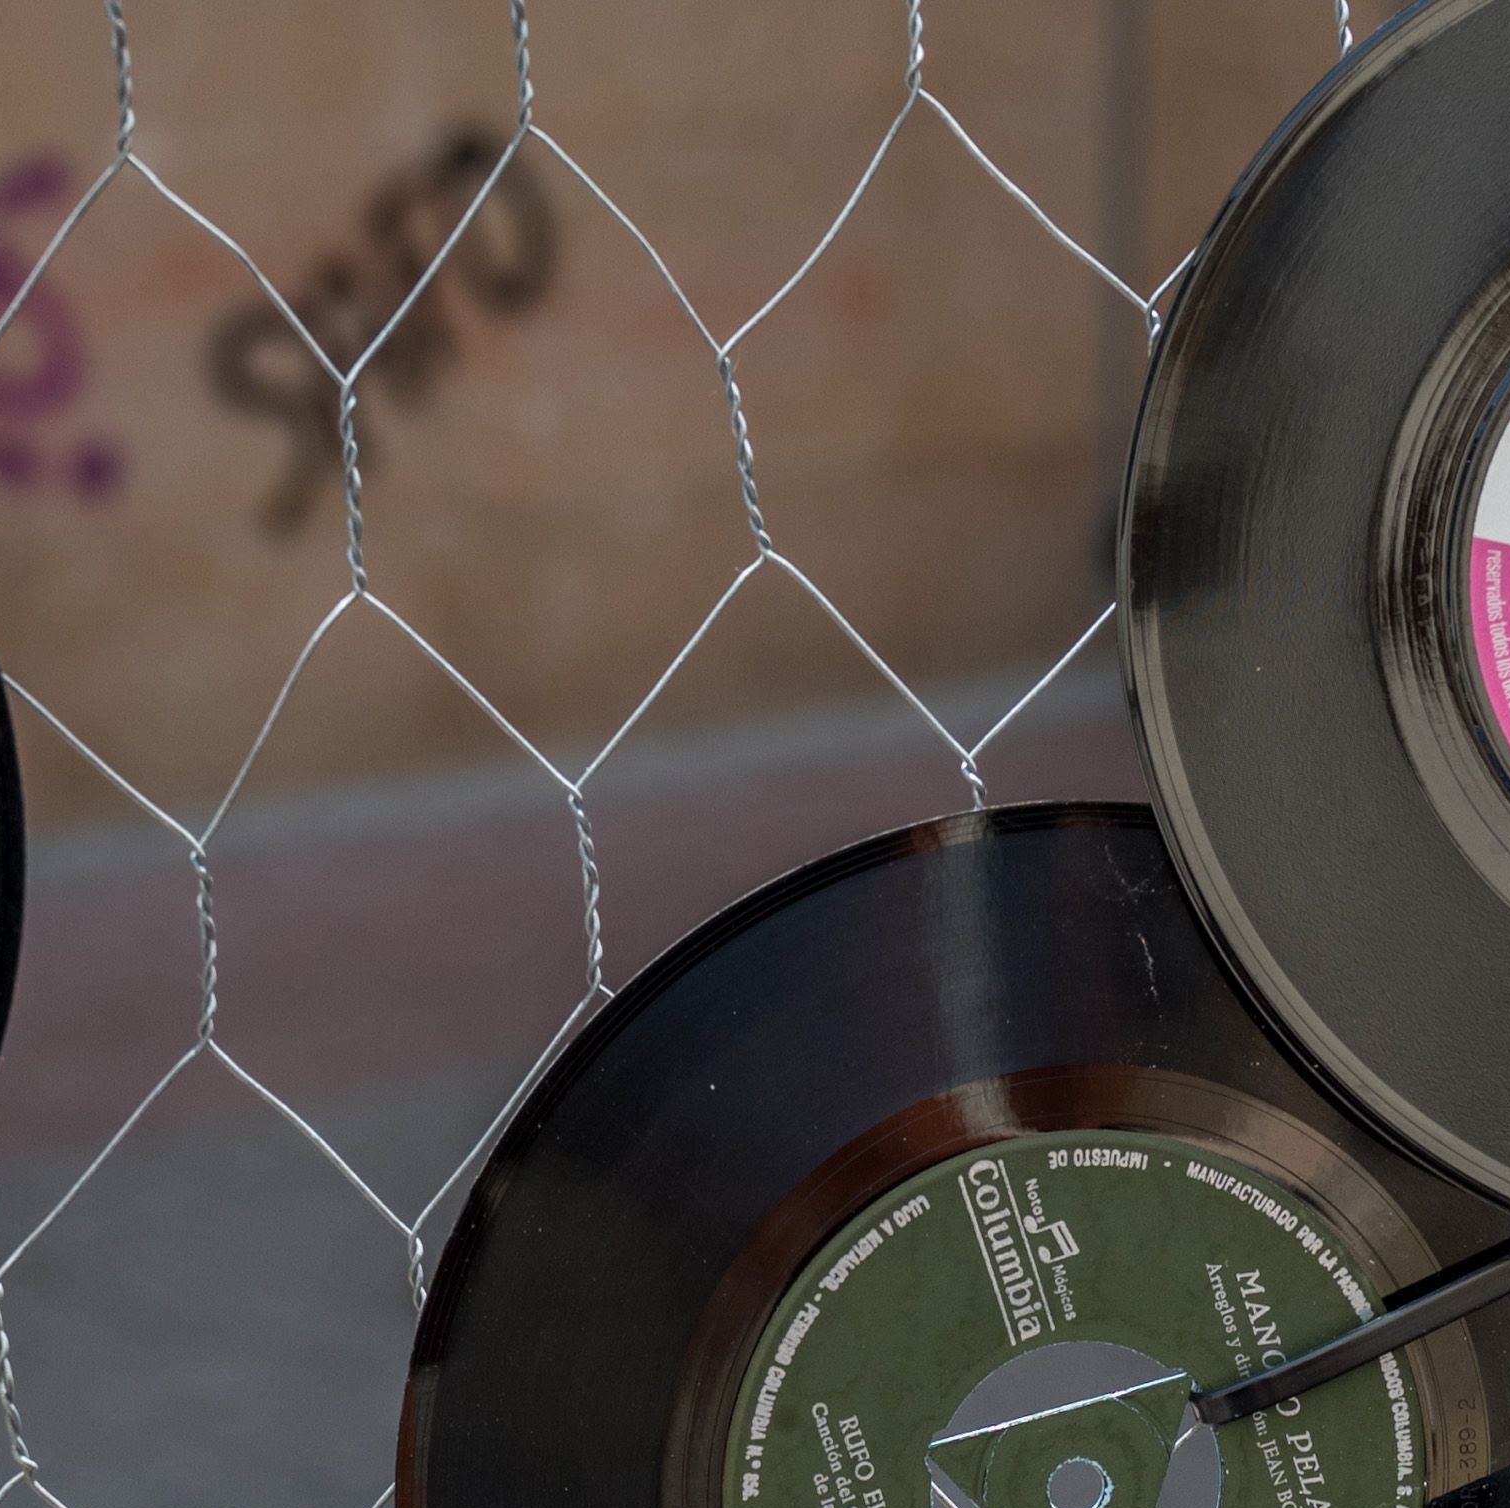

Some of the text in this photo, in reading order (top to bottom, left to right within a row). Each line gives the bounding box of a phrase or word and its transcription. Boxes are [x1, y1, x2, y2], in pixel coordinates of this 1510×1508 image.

[966, 1158, 1044, 1343] Columbia
[1185, 1159, 1339, 1273] MANUFACTURADO POR LA
[1050, 1262, 1078, 1323] Mágicas
[1204, 1262, 1239, 1335] Arreglos
[1224, 1335, 1243, 1349] y
[1255, 1437, 1289, 1487] JEAN
[810, 1401, 844, 1475] Canción
[834, 1475, 857, 1506] del
[812, 1472, 831, 1497] de
[837, 1413, 876, 1483] RUFO
